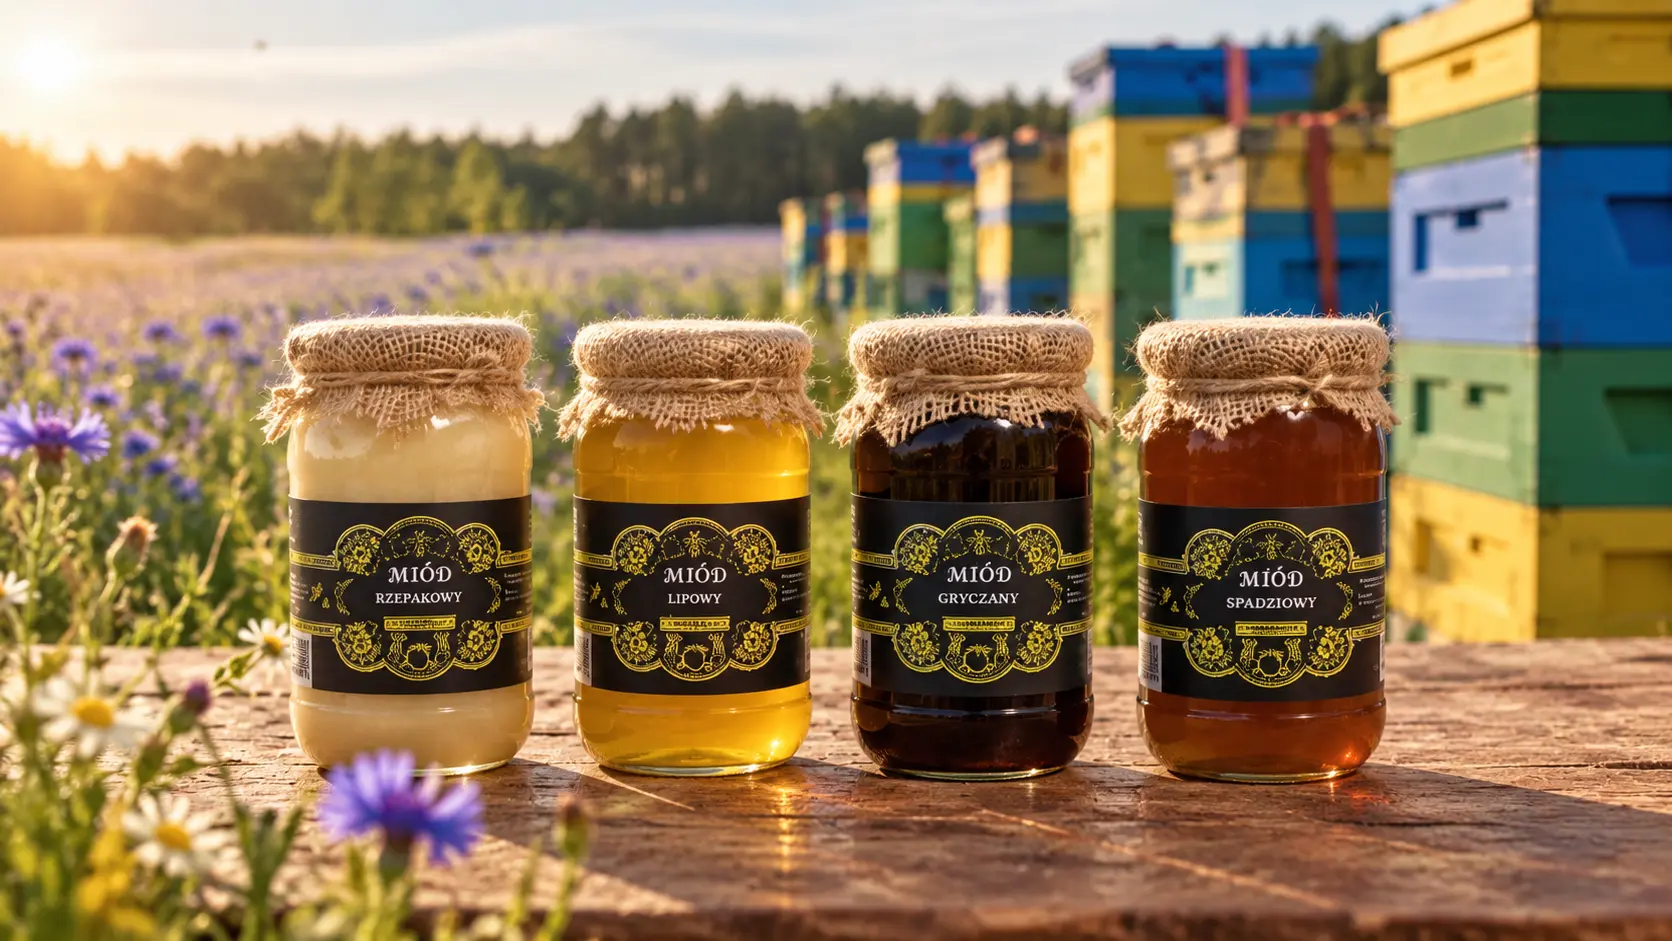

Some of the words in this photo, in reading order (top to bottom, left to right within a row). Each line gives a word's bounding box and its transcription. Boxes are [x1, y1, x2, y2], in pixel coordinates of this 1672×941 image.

[386, 561, 452, 584] MIÓD
[663, 561, 727, 584] MIÓD
[946, 561, 1012, 583] MIÓD
[375, 591, 463, 604] RZEPAKOWY
[667, 593, 722, 605] LIPOWY
[937, 592, 1020, 605] GRYCZANY
[1226, 596, 1317, 609] SPADZIOWY
